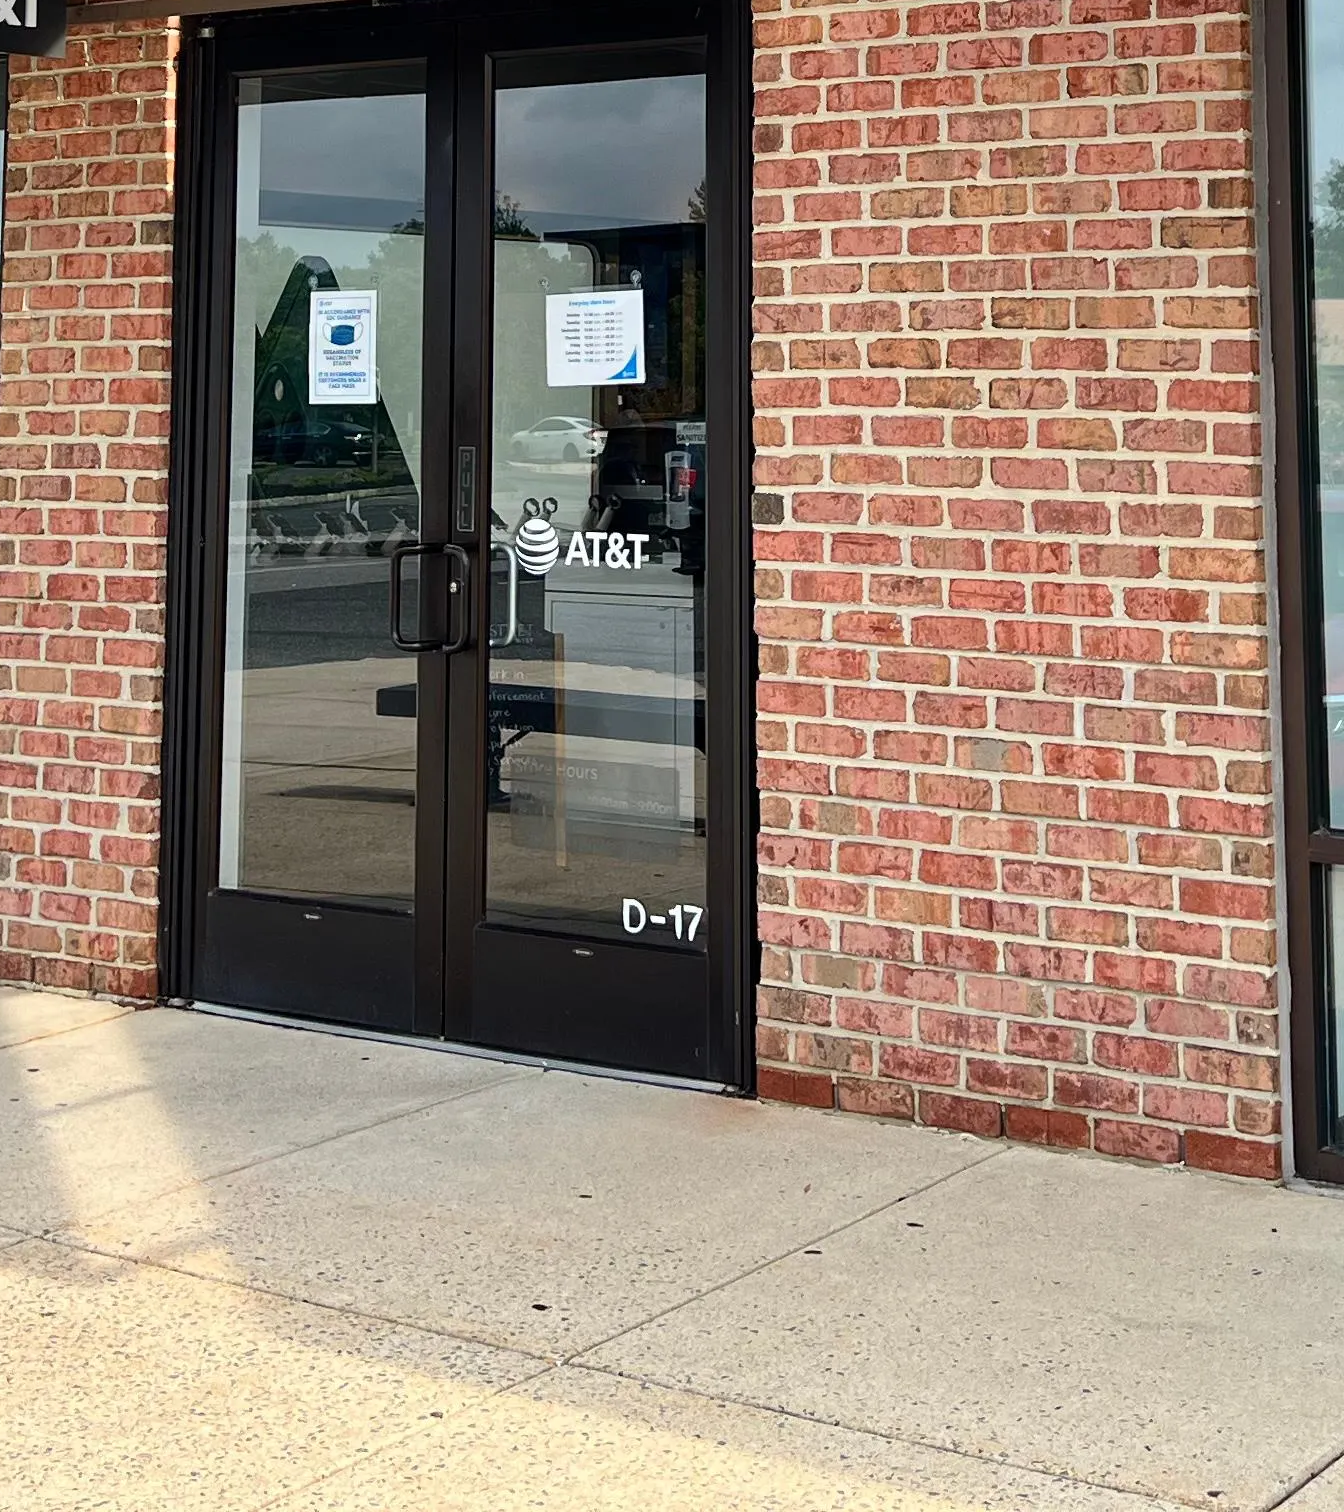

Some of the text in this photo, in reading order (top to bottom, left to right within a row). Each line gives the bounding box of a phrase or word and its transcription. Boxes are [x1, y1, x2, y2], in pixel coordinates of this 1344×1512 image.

[460, 451, 471, 526] PULL
[564, 531, 650, 570] AT&T
[622, 898, 704, 942] D-17
